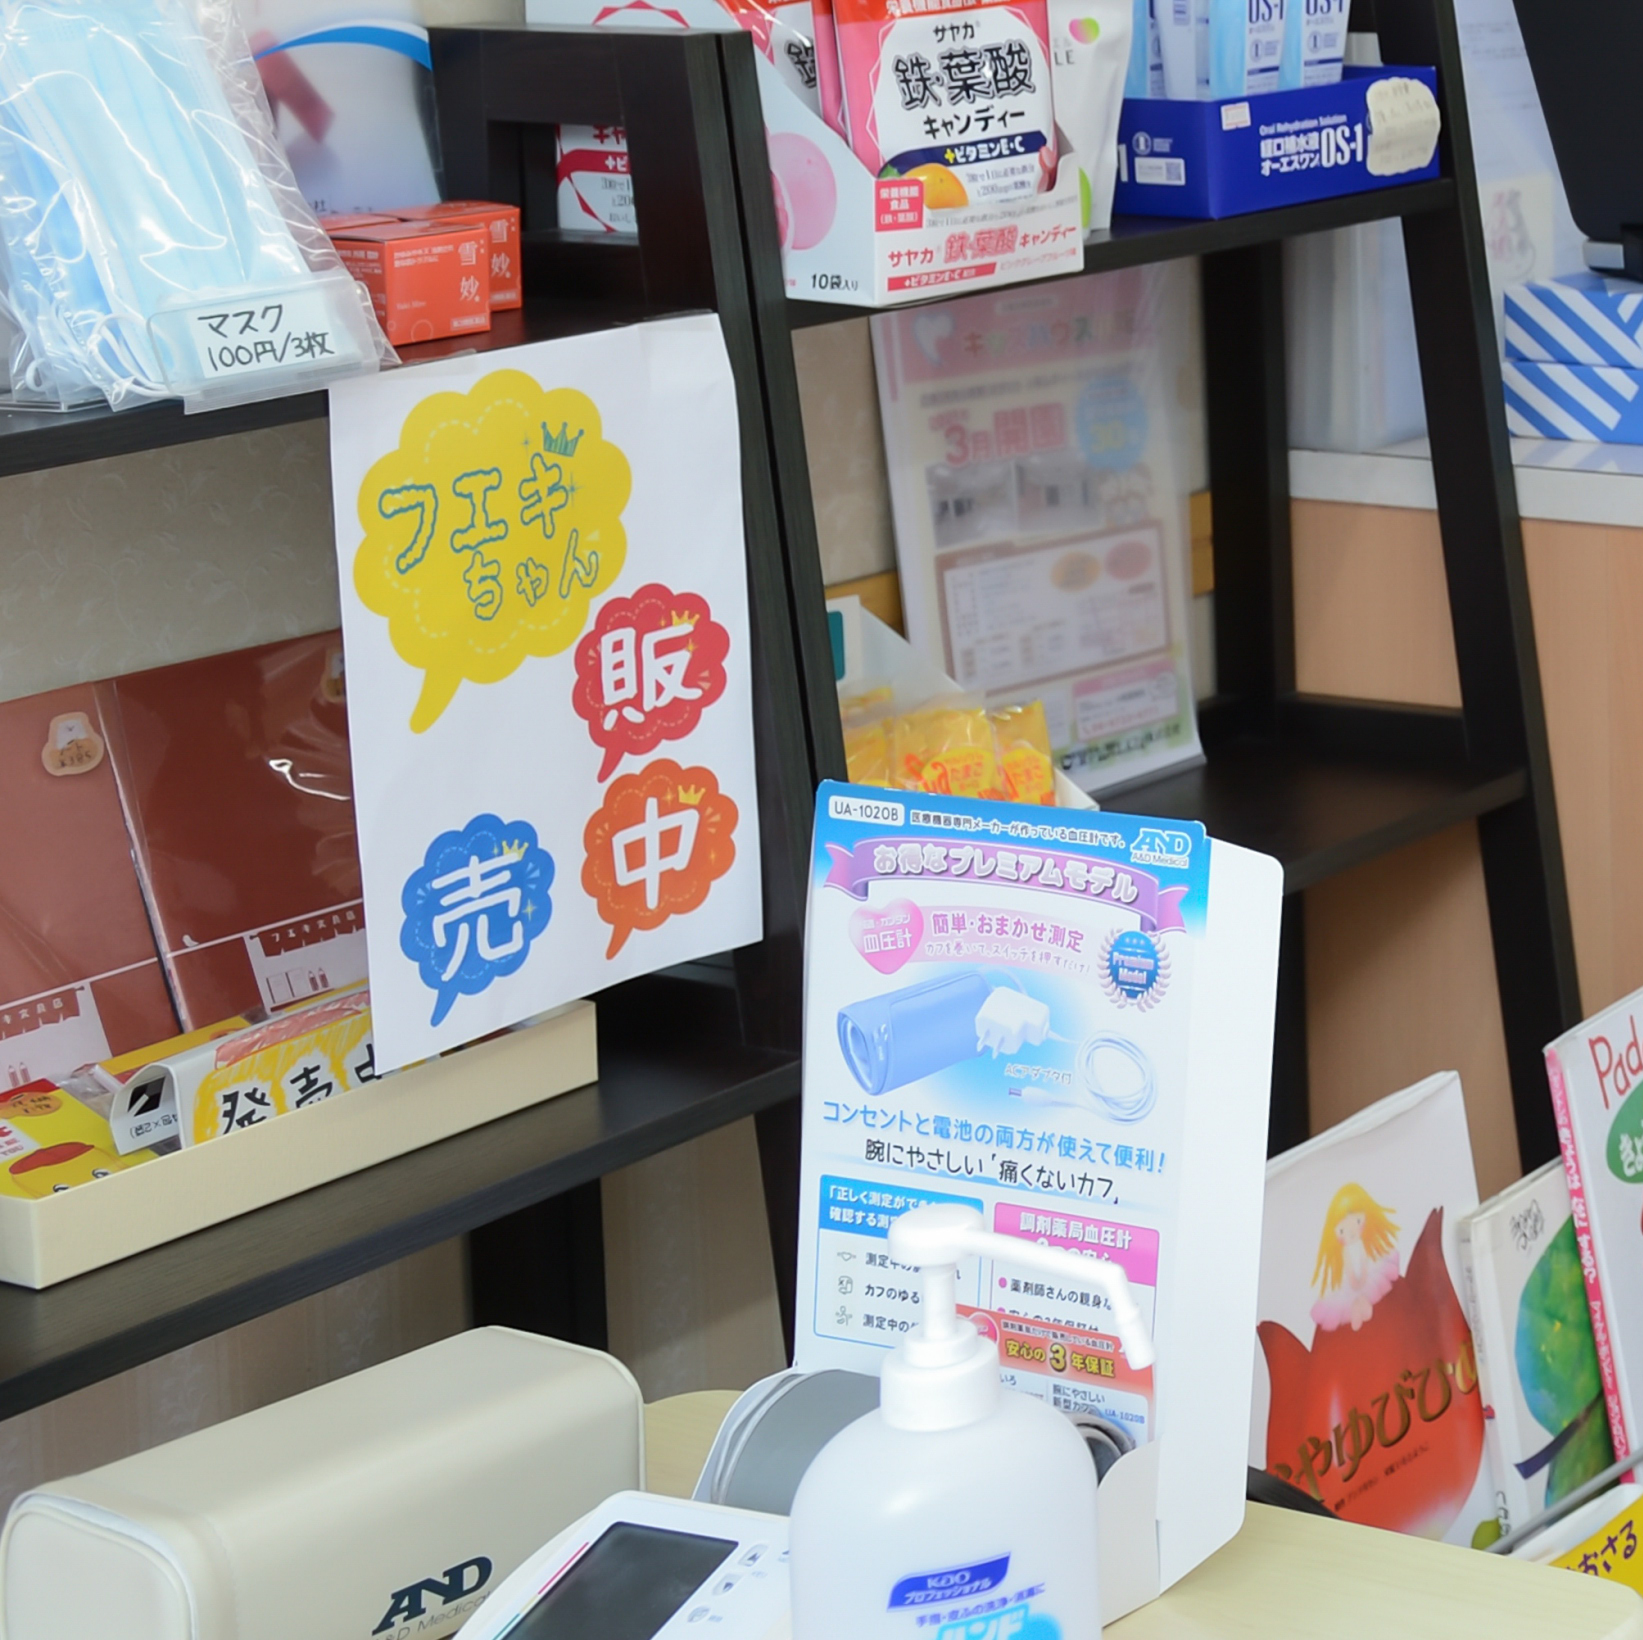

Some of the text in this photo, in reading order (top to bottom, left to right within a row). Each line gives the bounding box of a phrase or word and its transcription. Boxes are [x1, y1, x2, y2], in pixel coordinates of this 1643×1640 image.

[932, 23, 977, 43] サヤカ
[893, 39, 1037, 110] 鉄・葉酸
[922, 106, 1027, 140] キャンディー
[1320, 123, 1363, 168] OS-1
[887, 247, 935, 268] サヤカ
[1019, 223, 1078, 249] キャンディー
[198, 305, 285, 340] マスク
[207, 330, 337, 372] 100円/3枚
[377, 452, 570, 575] フエキ
[463, 527, 600, 622] ちゃん
[600, 622, 704, 733] 販
[834, 801, 900, 822] UA-1020B
[611, 796, 700, 911] 中
[873, 842, 1139, 904] お得なプレミアムモデル
[431, 850, 526, 983] 売
[931, 912, 1085, 954] 簡単・おまかせ測定
[863, 929, 913, 954] 血圧計
[864, 1138, 1121, 1205] 腕にやさしい「痛くないカフ」
[1019, 1211, 1132, 1251] 調剤薬局血圧計
[1273, 1341, 1478, 1503] やゆびひ
[1567, 1519, 1639, 1578] おさる
[903, 1576, 993, 1606] プロフェッショナル
[926, 1570, 971, 1591] Kao
